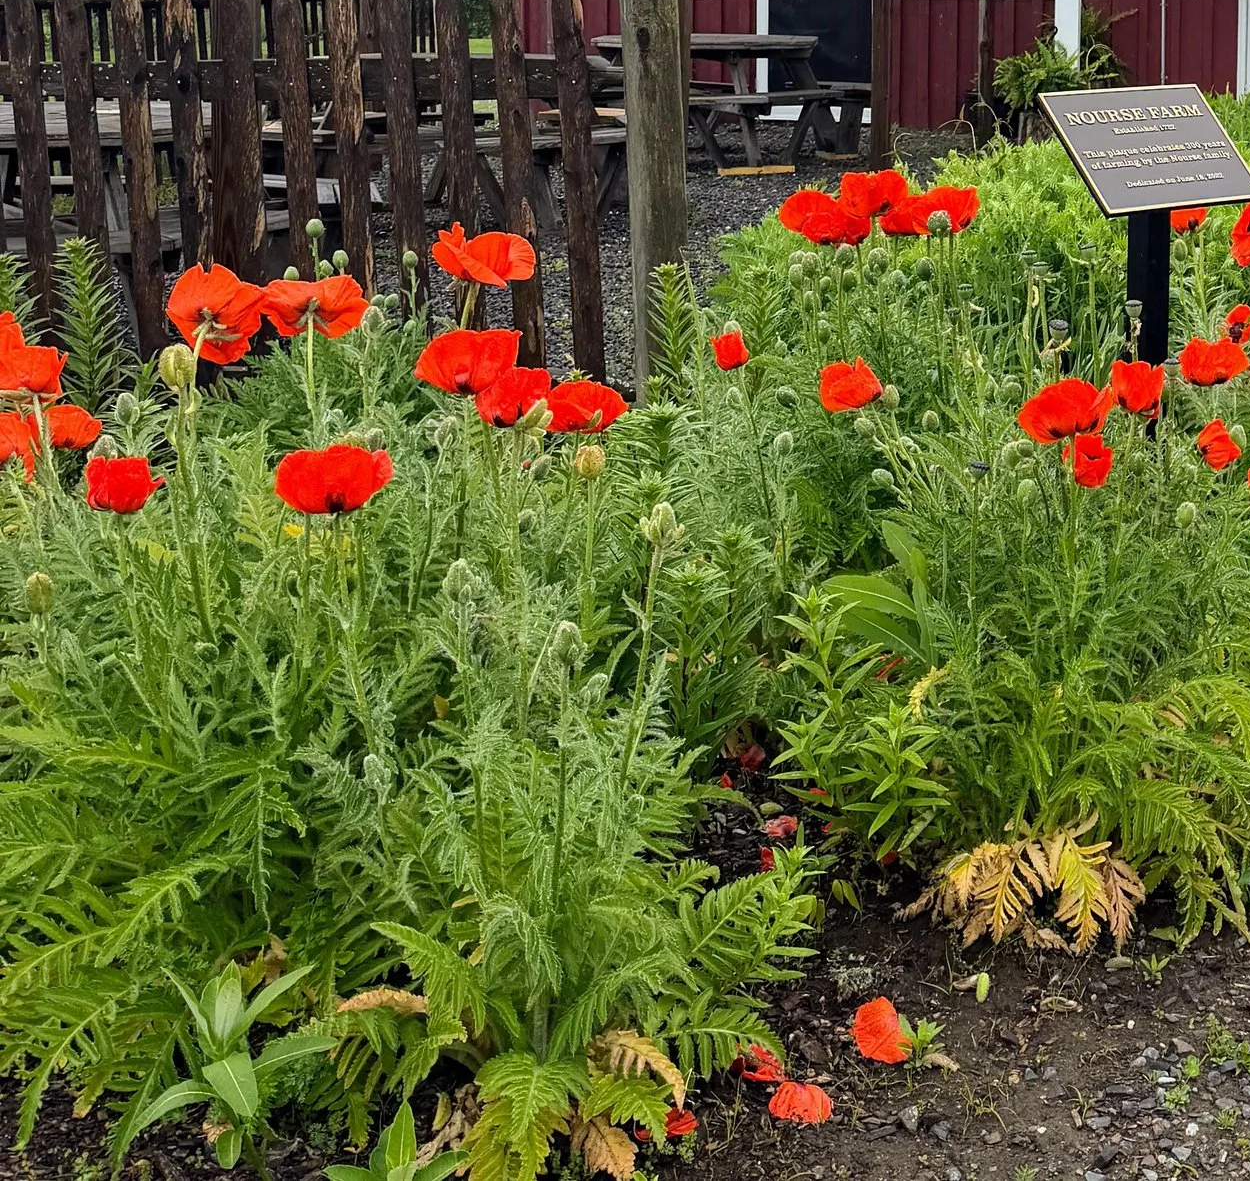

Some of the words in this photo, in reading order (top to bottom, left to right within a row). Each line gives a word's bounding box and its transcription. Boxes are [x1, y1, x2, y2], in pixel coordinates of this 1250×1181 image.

[1064, 107, 1148, 125] NOURSE
[1146, 104, 1204, 119] FARM
[1112, 124, 1160, 135] Established
[1082, 150, 1106, 159] This
[1106, 148, 1139, 159] plaque
[1139, 144, 1186, 155] celebrates
[1201, 140, 1226, 151] years
[1091, 161, 1102, 170] of
[1102, 158, 1141, 169] farming
[1140, 157, 1153, 167] by
[1154, 155, 1170, 165] the
[1169, 153, 1203, 163] Nourse
[1203, 150, 1233, 161] family.
[1125, 177, 1165, 188] Dedicated
[1165, 177, 1177, 185] on
[1176, 174, 1195, 184] June
